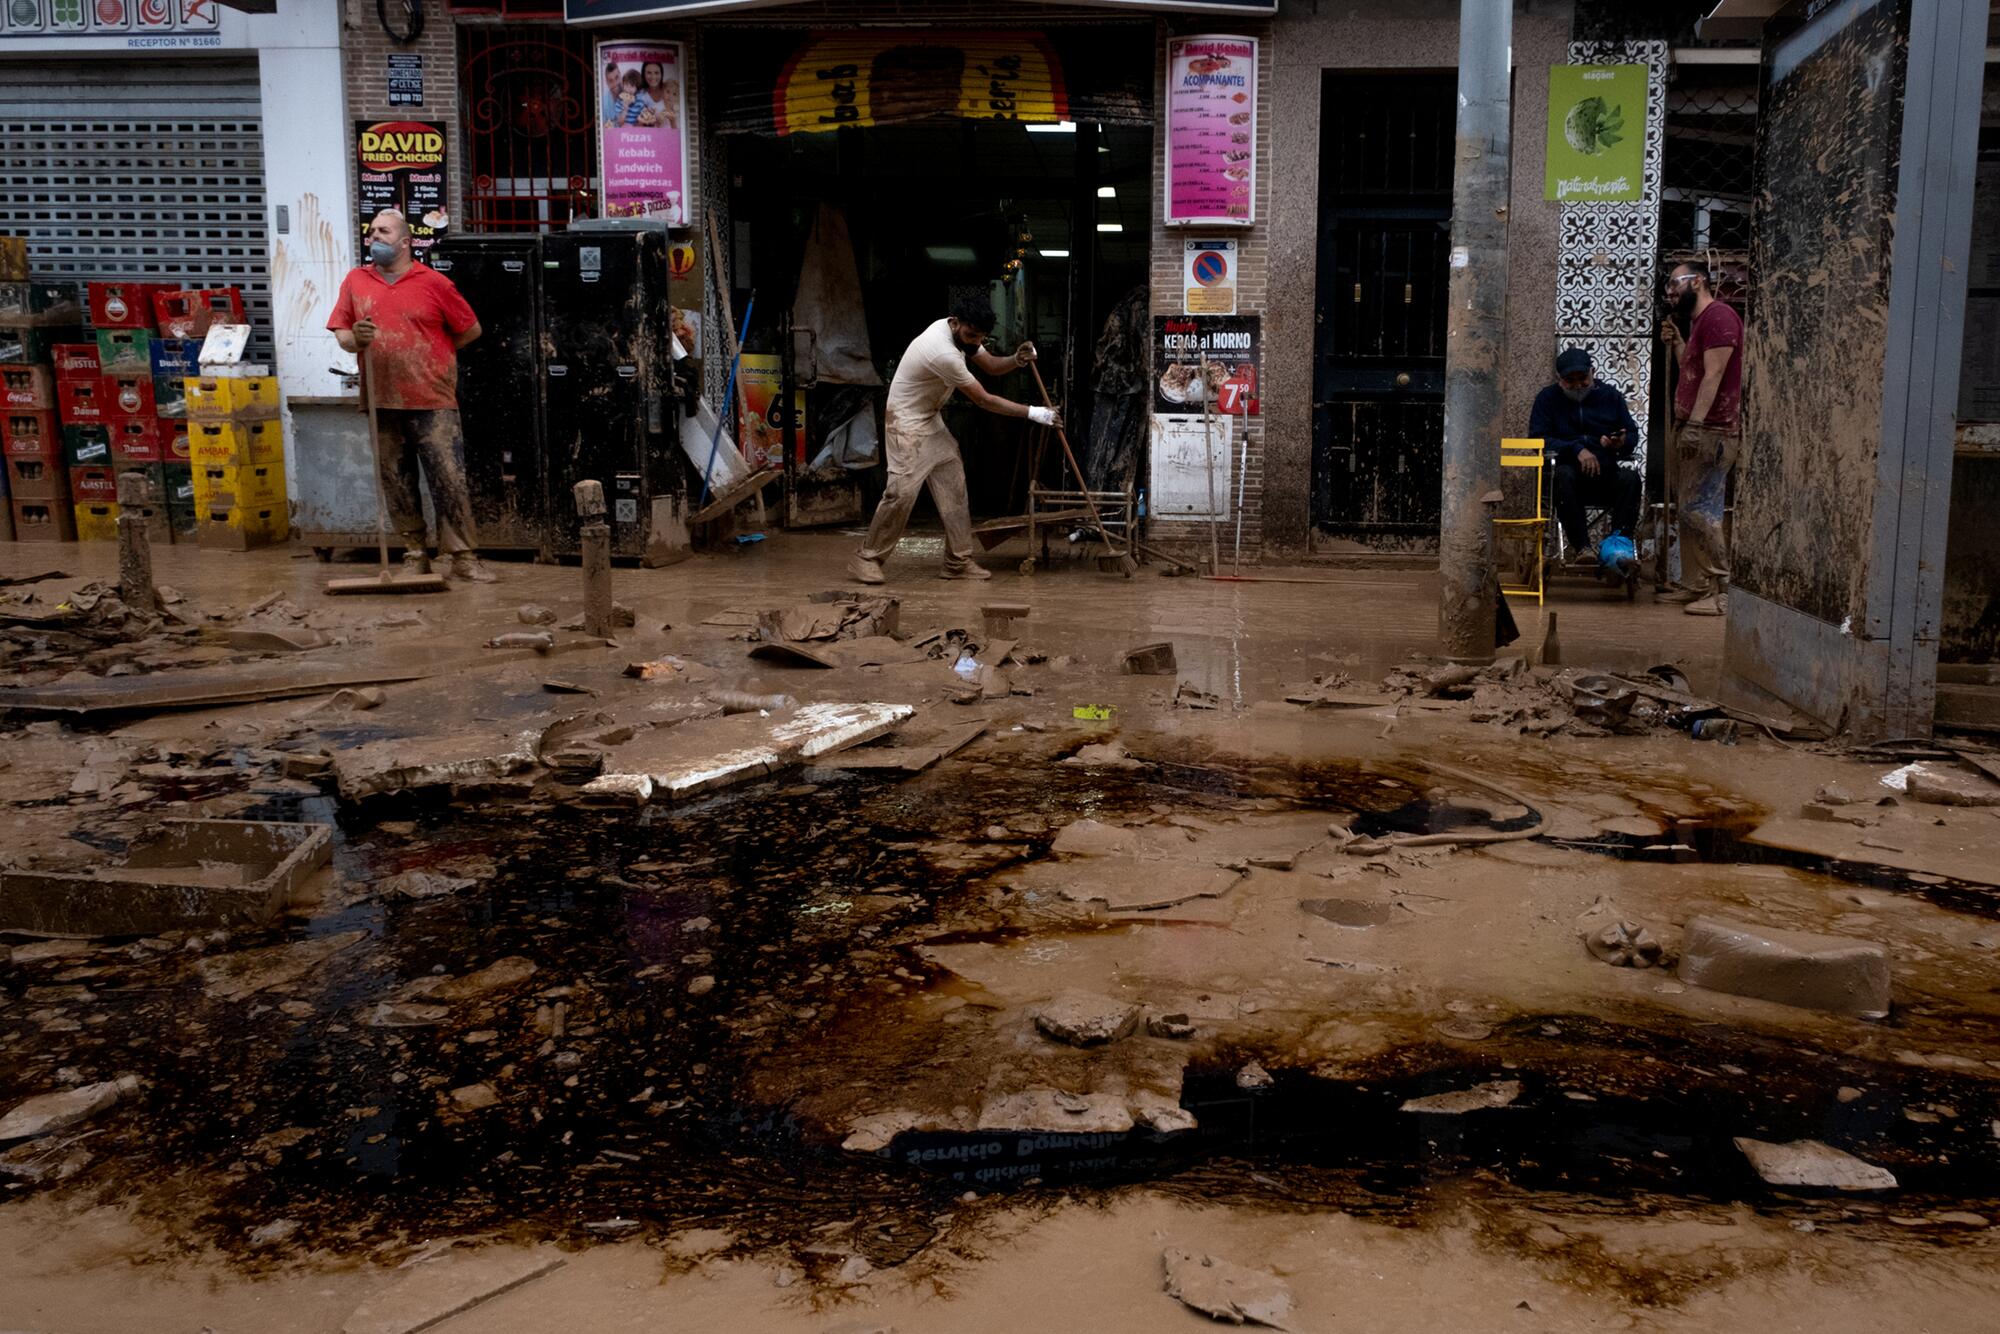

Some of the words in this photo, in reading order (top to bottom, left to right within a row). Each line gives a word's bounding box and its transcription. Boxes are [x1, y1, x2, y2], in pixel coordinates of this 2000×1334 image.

[128, 39, 177, 47] RECEPTOR
[193, 37, 221, 46] 81660
[1186, 42, 1215, 53] David
[1217, 42, 1249, 54] Kebab
[1183, 73, 1245, 87] ACOMPAÑANTES
[361, 132, 443, 153] DAVID
[620, 132, 652, 143] Pizzas
[362, 153, 394, 163] FRIED
[396, 153, 443, 163] CHICKEN
[618, 148, 656, 158] Kebabs
[614, 163, 663, 173] Sandwich
[362, 173, 387, 182] Menú
[388, 174, 393, 182] 1
[409, 174, 434, 183] Menú
[608, 178, 673, 189] Hamburguesas
[1164, 320, 1198, 333] Nuevo
[1164, 334, 1198, 349] KEBAB
[1200, 334, 1210, 349] al
[1212, 332, 1251, 349] HORNO
[63, 360, 99, 369] AMSTEL
[1224, 383, 1239, 409] 7
[1239, 383, 1250, 393] 50
[72, 405, 100, 416] Damm
[122, 444, 150, 454] Damm
[198, 446, 230, 456] AMBAR
[80, 481, 115, 490] AMSTEL
